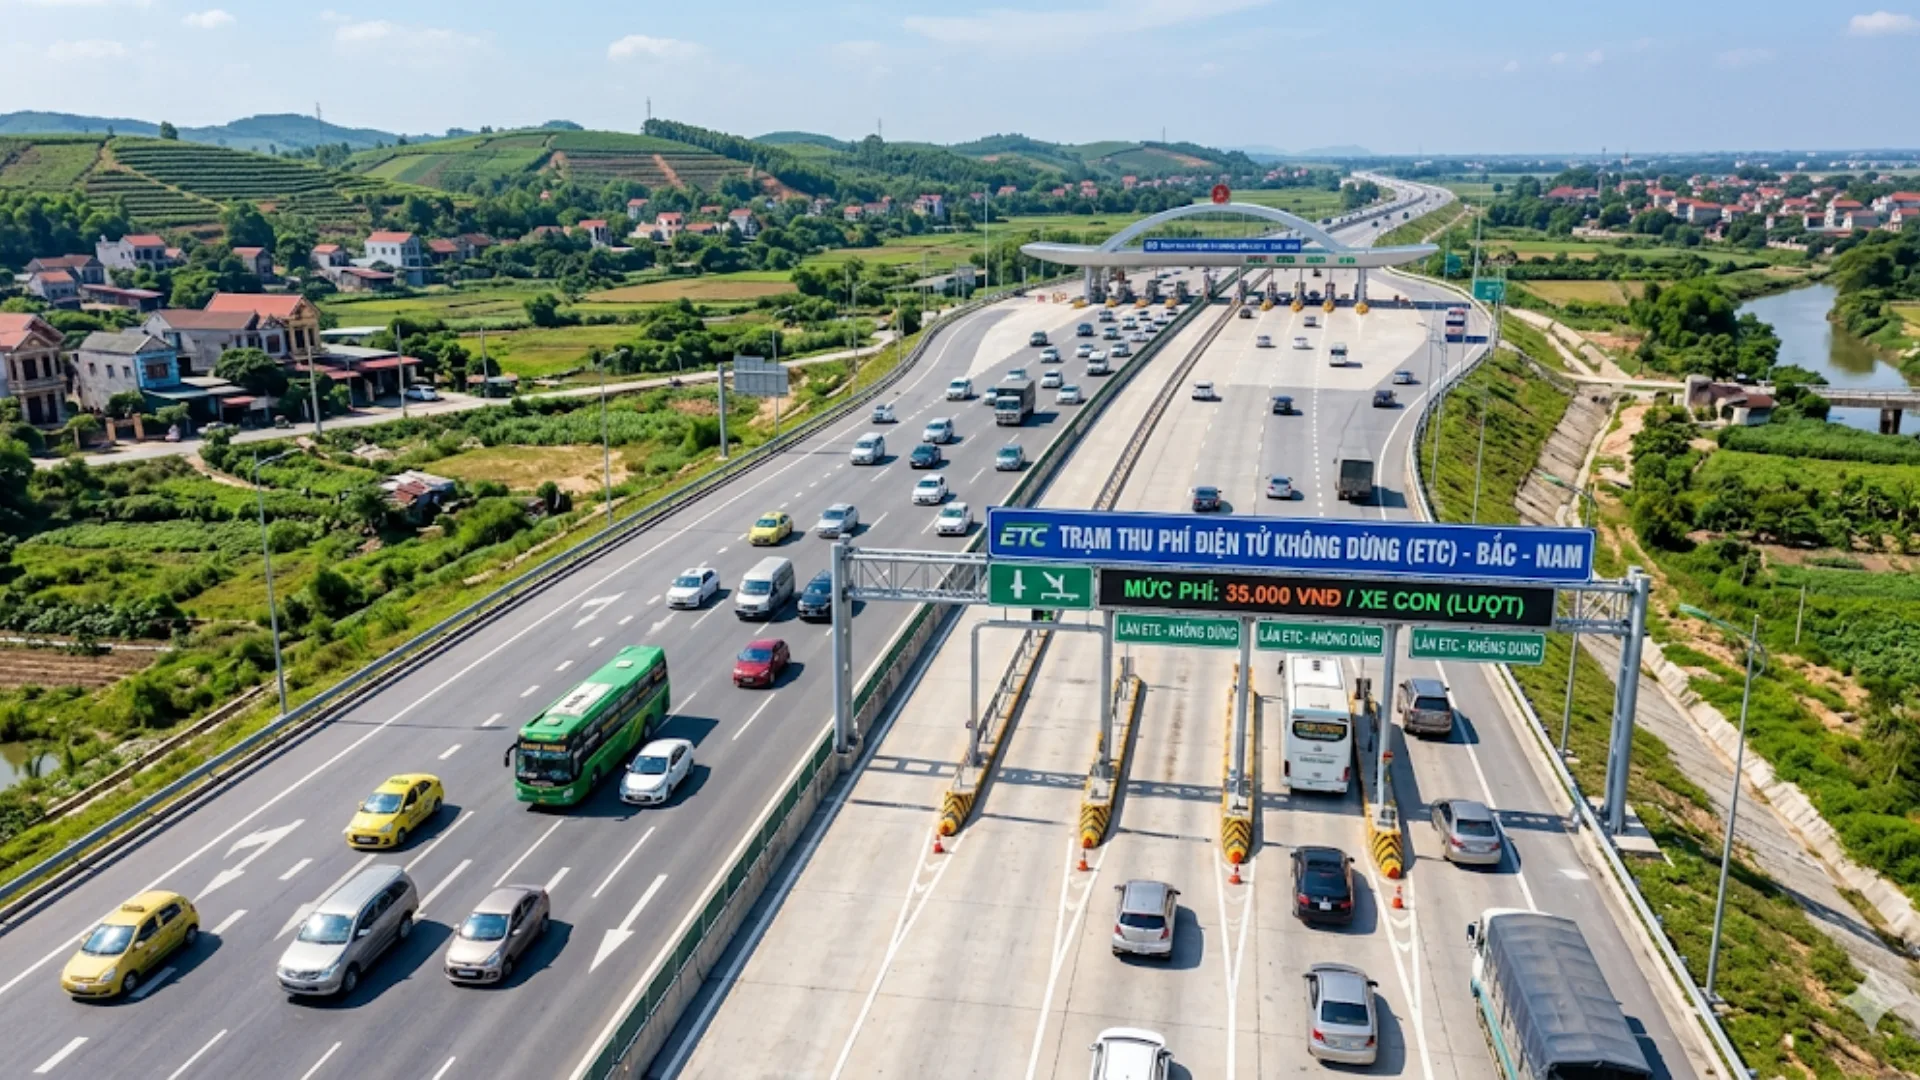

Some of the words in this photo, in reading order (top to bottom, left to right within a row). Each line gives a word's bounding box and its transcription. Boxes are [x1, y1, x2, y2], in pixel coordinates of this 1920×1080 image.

[999, 526, 1049, 548] ETC
[1059, 525, 1112, 555] TRẠM
[1117, 527, 1154, 552] THU
[1158, 525, 1192, 553] PHÍ
[1195, 527, 1240, 559] ĐIỆN
[1245, 525, 1272, 557] TỬ
[1274, 529, 1341, 559] KHÔNG
[1406, 538, 1458, 567] (ETC)
[1476, 531, 1518, 567] BẮC
[1535, 543, 1584, 569] NAM
[1124, 577, 1173, 600] MỨC
[1179, 579, 1220, 602] PHÍ:
[1226, 582, 1291, 605] 35.000
[1296, 585, 1342, 608] VNĐ
[1346, 589, 1355, 607] /
[1358, 589, 1388, 610] XE
[1393, 591, 1441, 612] CON
[1446, 593, 1525, 620] (LƯỢT)
[1282, 629, 1304, 644] ETC
[1438, 637, 1460, 652] ETC
